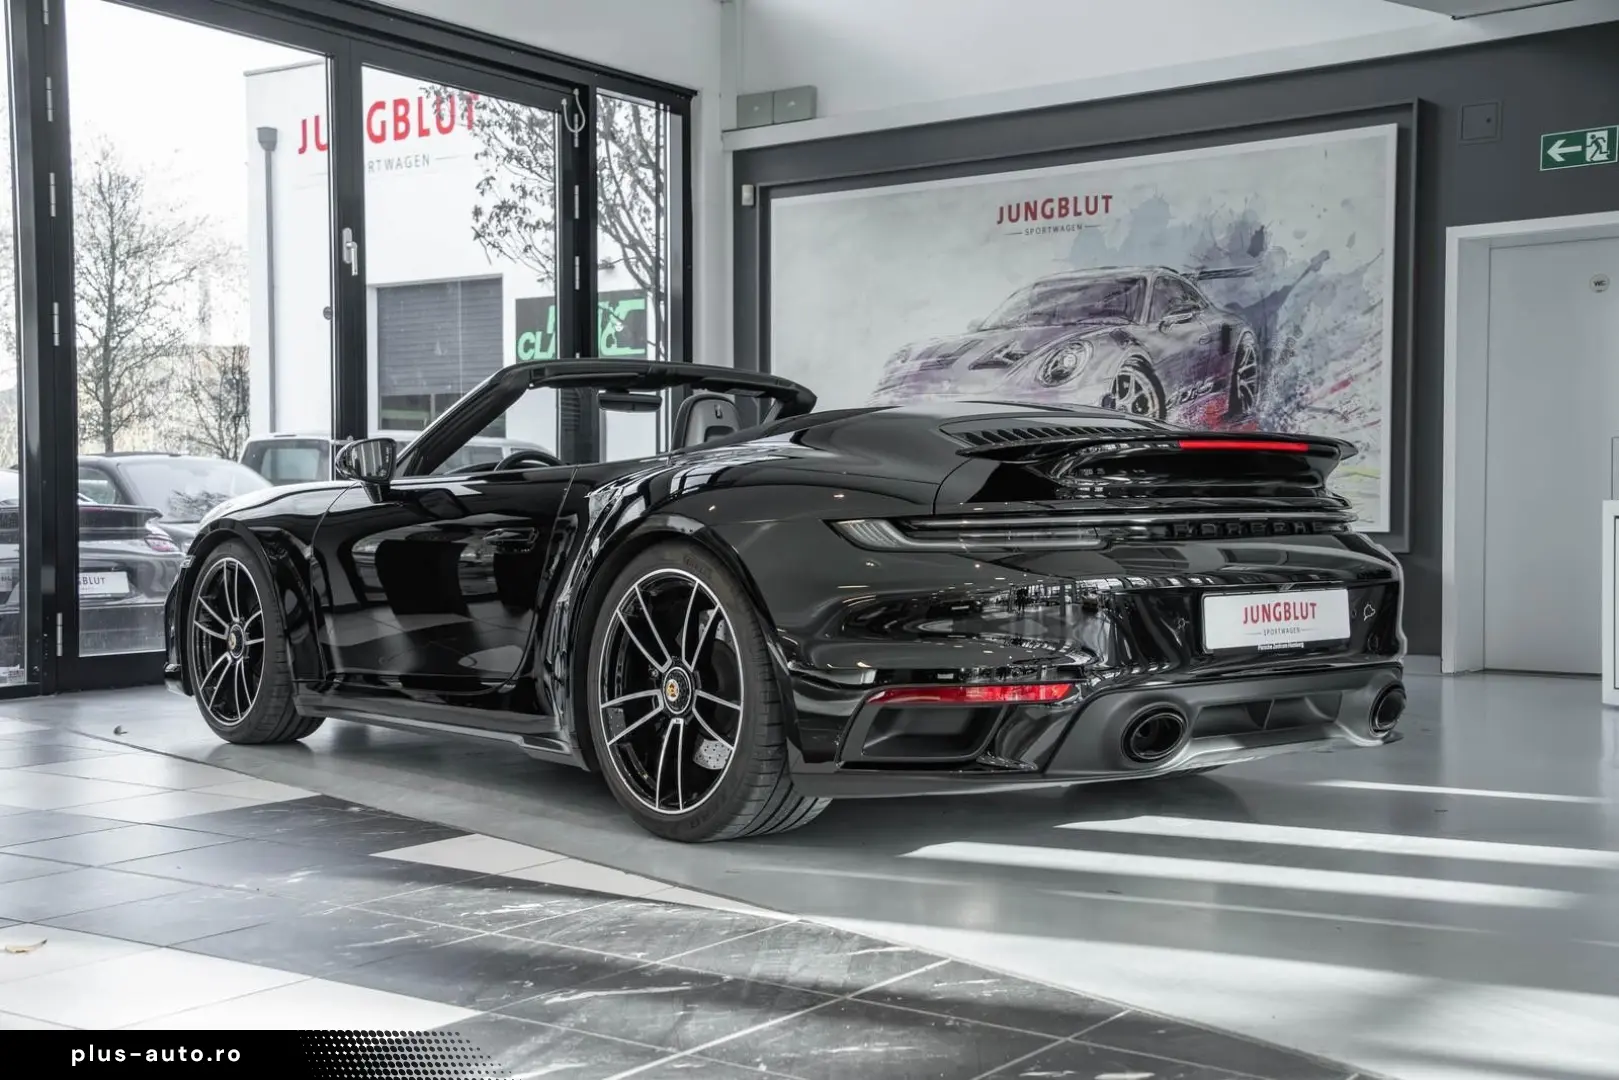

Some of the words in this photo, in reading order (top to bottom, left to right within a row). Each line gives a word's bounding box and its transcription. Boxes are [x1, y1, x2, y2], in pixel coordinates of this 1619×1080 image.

[298, 91, 480, 155] JUGBLUT
[367, 153, 430, 173] RTWAGEN
[997, 195, 1113, 225] JUNGBLUT
[1024, 224, 1083, 235] SPORTWAGEN
[79, 577, 106, 585] BLUT
[1243, 602, 1317, 625] JUNGBLUT
[1263, 627, 1301, 636] SPORTWAGEN
